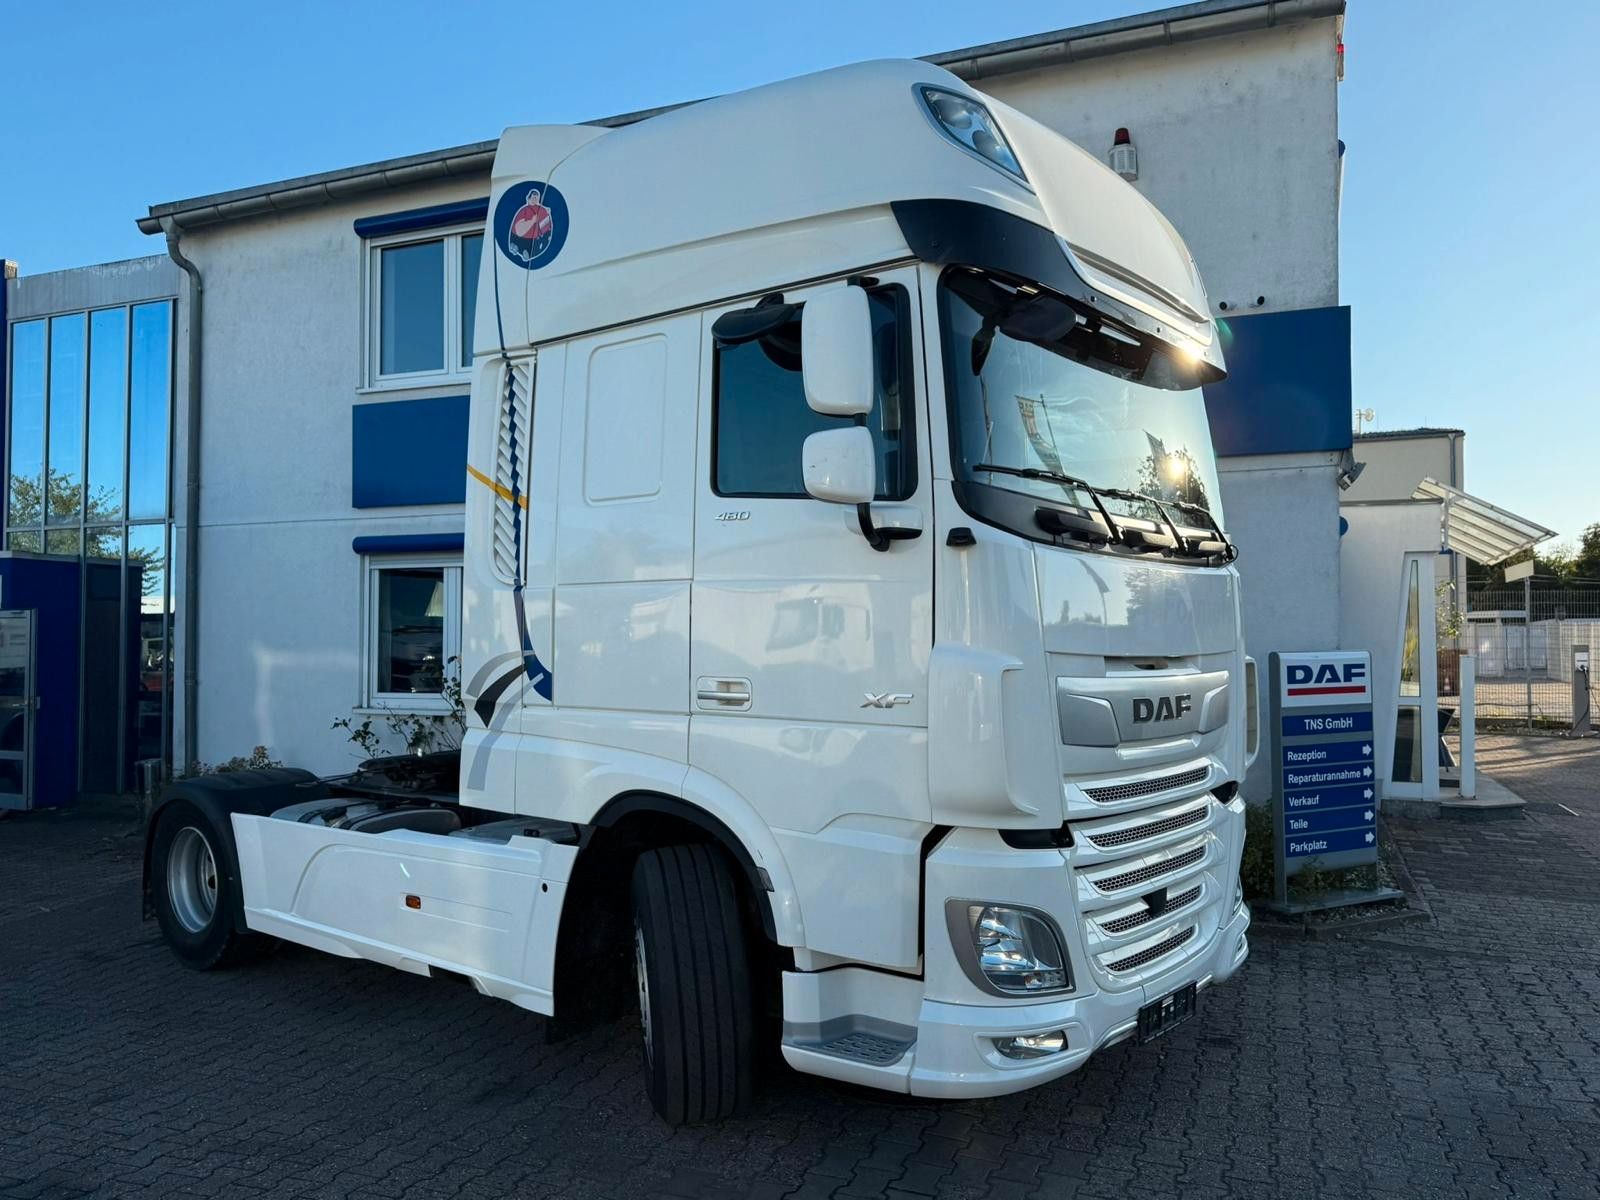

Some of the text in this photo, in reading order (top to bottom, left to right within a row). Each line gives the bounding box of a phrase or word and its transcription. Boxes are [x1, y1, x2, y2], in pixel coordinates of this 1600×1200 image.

[714, 511, 751, 522] 480
[1286, 663, 1366, 685] DAF
[860, 692, 914, 709] XF
[1132, 694, 1192, 724] DAF
[1304, 717, 1353, 731] TNS GmbH
[1287, 750, 1327, 762] Rezeption
[1288, 769, 1361, 785] Reparaturannahme
[1288, 795, 1320, 807] Verkauf
[1289, 818, 1308, 830] Teile
[1290, 840, 1328, 854] Parkplatz
